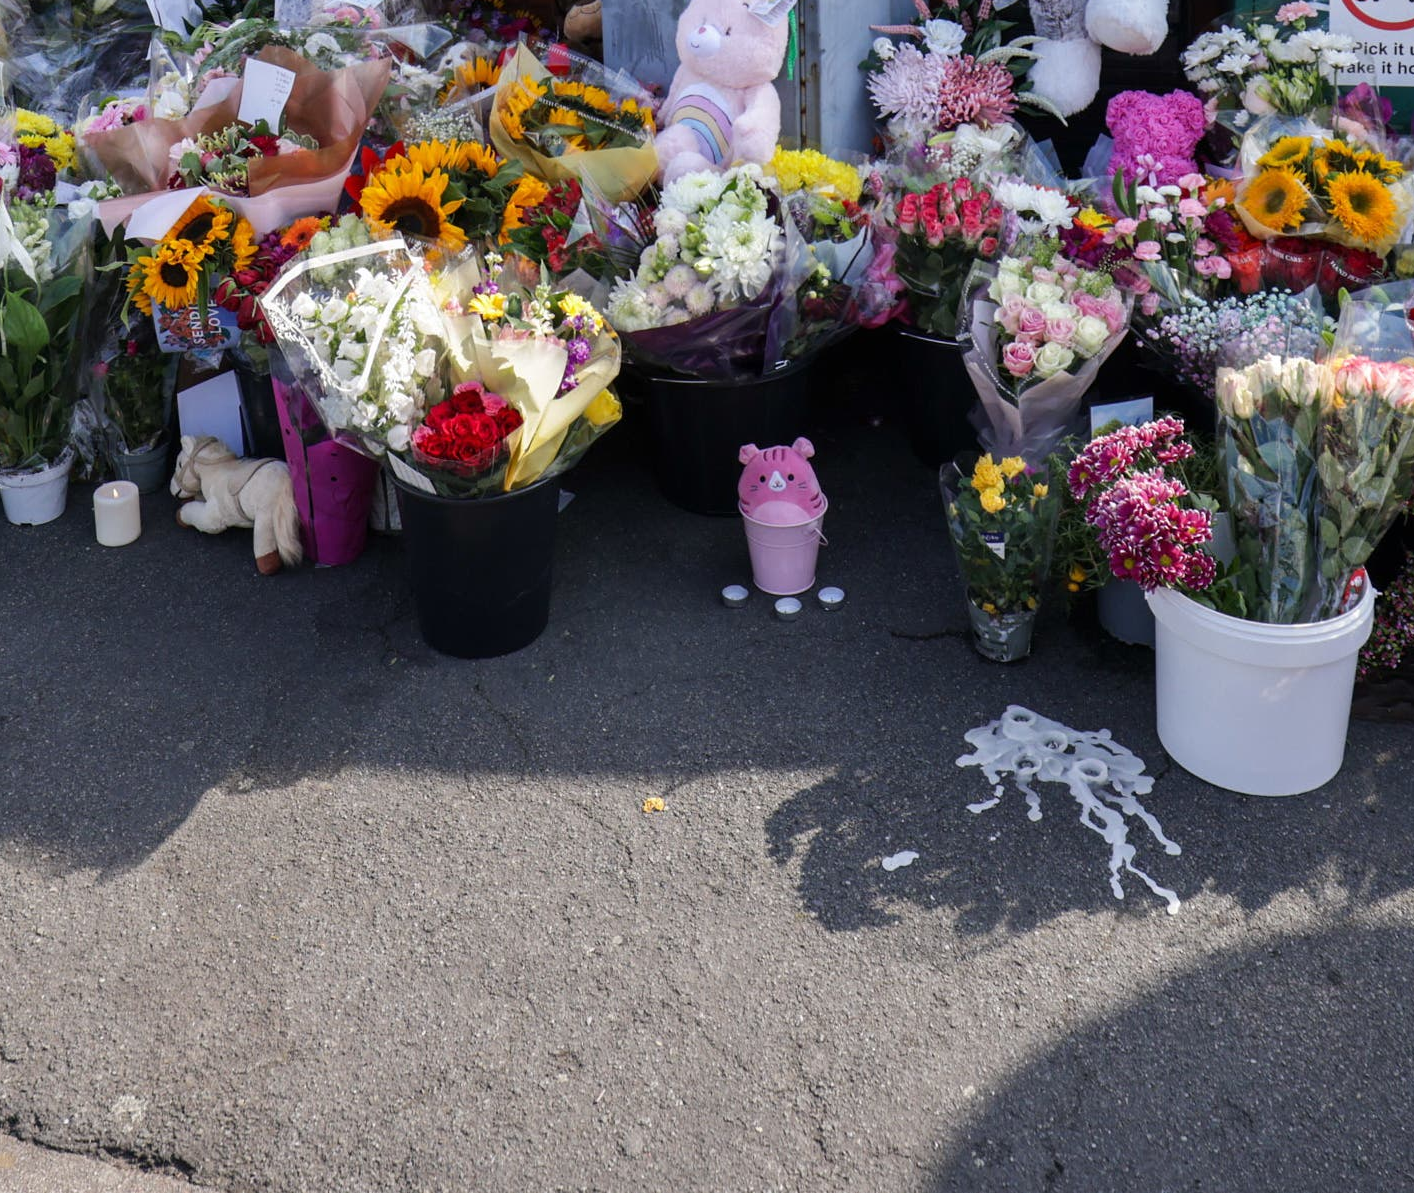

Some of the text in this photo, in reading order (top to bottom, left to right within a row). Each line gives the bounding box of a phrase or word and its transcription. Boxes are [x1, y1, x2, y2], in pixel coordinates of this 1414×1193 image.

[1352, 42, 1388, 56] Pick
[1393, 42, 1404, 56] it
[1339, 61, 1376, 75] ake
[1381, 61, 1392, 75] it
[188, 304, 206, 345] SENDI
[208, 299, 222, 335] LOVE
